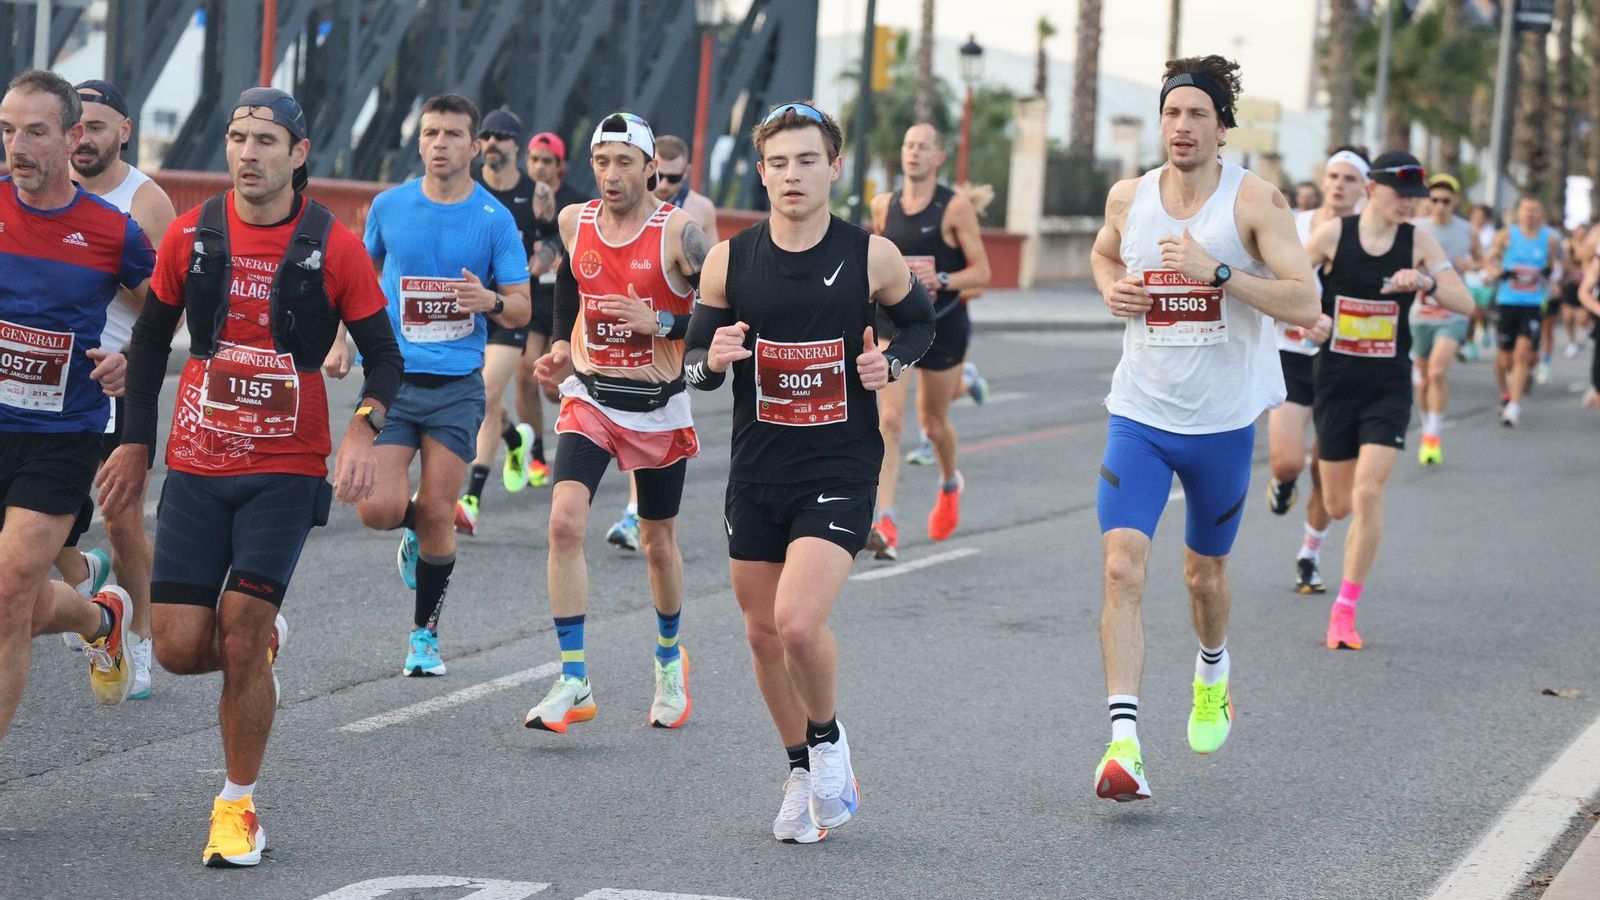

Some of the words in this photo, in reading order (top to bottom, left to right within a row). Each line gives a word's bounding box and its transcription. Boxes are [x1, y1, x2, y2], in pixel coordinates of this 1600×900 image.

[62, 237, 89, 247] adidas
[230, 256, 279, 273] ENERALI
[229, 277, 271, 300] ÁLAG
[416, 301, 460, 314] 13273
[1159, 297, 1208, 312] 15503
[1, 326, 65, 348] GENERALI
[778, 345, 839, 360] GENERALI
[1, 353, 48, 374] 0577
[9, 370, 42, 381] JAKOBSEN
[778, 373, 823, 389] 3004
[32, 390, 49, 398] 21K
[229, 377, 272, 399] 1155
